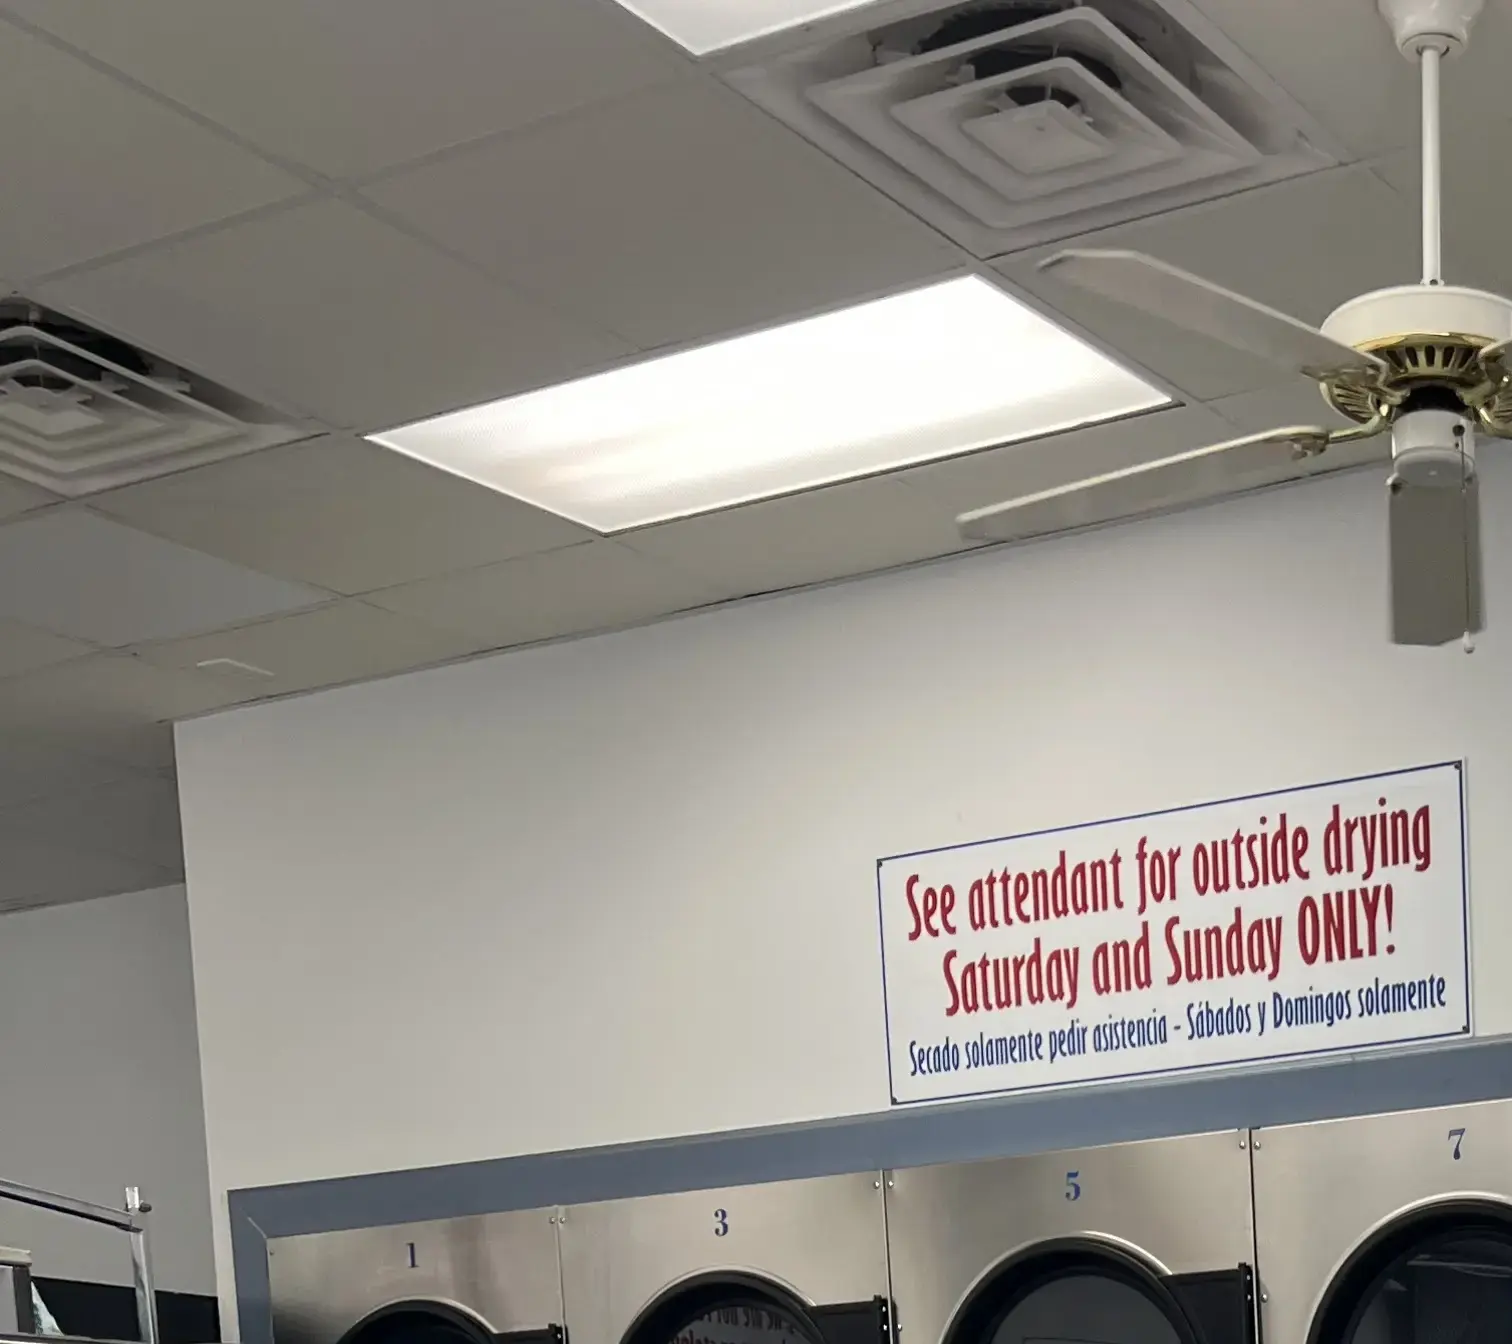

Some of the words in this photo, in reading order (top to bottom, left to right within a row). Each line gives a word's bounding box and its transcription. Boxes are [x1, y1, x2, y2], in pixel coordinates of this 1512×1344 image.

[906, 874, 957, 941] See
[968, 848, 1124, 931] attendant
[1135, 836, 1181, 915] for
[1193, 812, 1310, 897] outside
[1323, 797, 1431, 881] drying
[943, 937, 1080, 1017] Saturday
[1092, 920, 1153, 996] and
[1164, 906, 1283, 986] Sunday
[1297, 883, 1396, 966] ONLY!
[909, 1036, 960, 1077] Secado
[964, 1030, 1043, 1070] solamente
[1048, 1018, 1088, 1064] pedir
[1093, 1009, 1168, 1053] asistencia
[1186, 997, 1252, 1041] Sábados
[1257, 1001, 1266, 1037] y
[1272, 986, 1352, 1029] Domingos
[1357, 974, 1446, 1018] solamente
[1447, 1127, 1466, 1161] 7
[1065, 1171, 1081, 1201] 5
[714, 1208, 729, 1237] 3
[406, 1242, 418, 1268] 1
